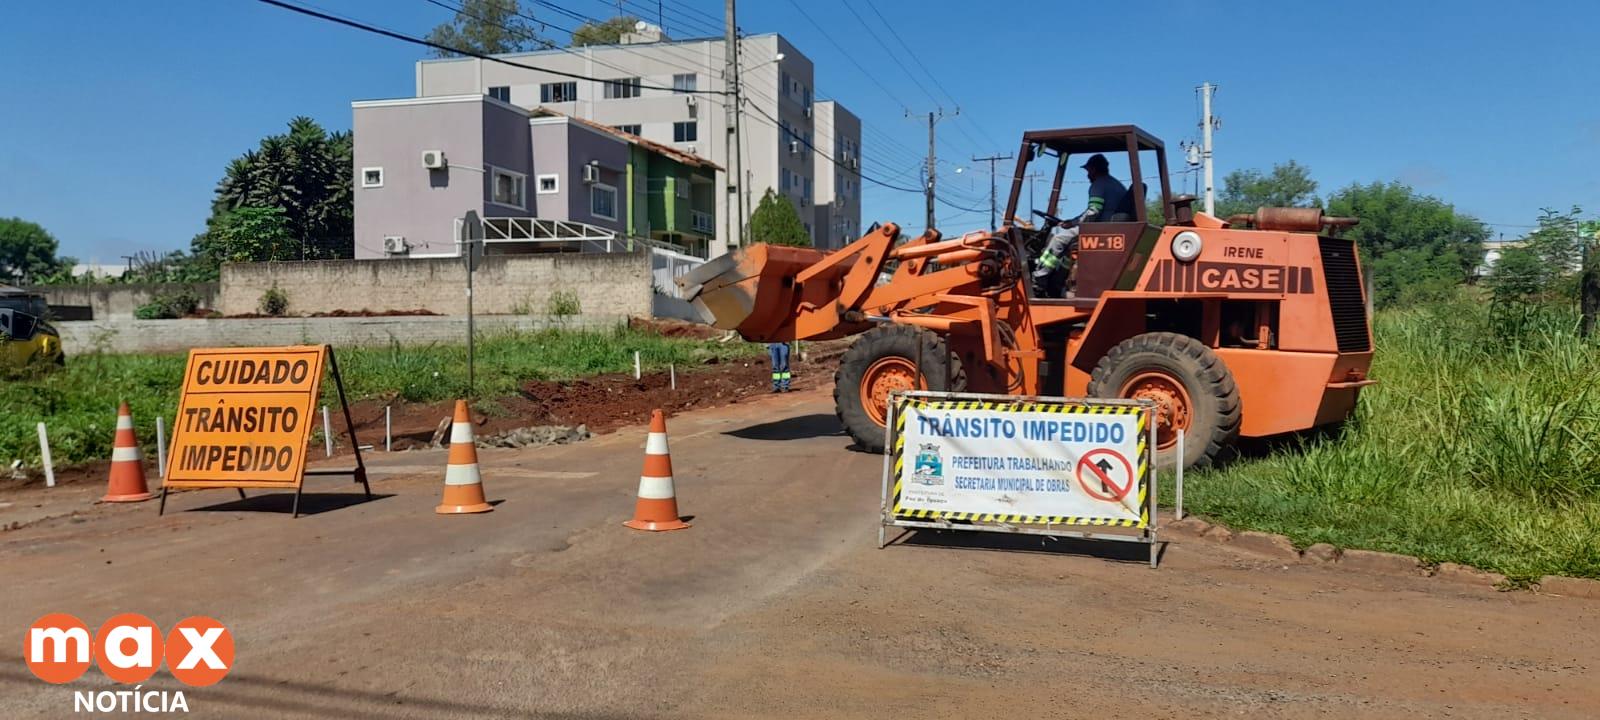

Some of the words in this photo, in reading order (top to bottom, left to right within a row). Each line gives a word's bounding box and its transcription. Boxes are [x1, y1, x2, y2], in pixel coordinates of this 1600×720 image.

[1081, 236, 1124, 250] W-18
[1223, 246, 1265, 260] IRENE
[1201, 268, 1281, 290] CASE
[196, 359, 309, 386] CUIDADO
[184, 398, 299, 433] TRÂNSITO
[917, 413, 1016, 439] TRÂNSITO
[1023, 419, 1125, 444] IMPEDIDO
[179, 445, 293, 472] IMPEDIDO
[952, 456, 1005, 470] PREFEITURA
[1007, 457, 1073, 473] TRABALHANDO
[954, 476, 996, 491] SECRETARIA
[997, 478, 1034, 492] MUNICIPAL
[1035, 478, 1045, 492] DE
[1046, 479, 1071, 493] OBRAS
